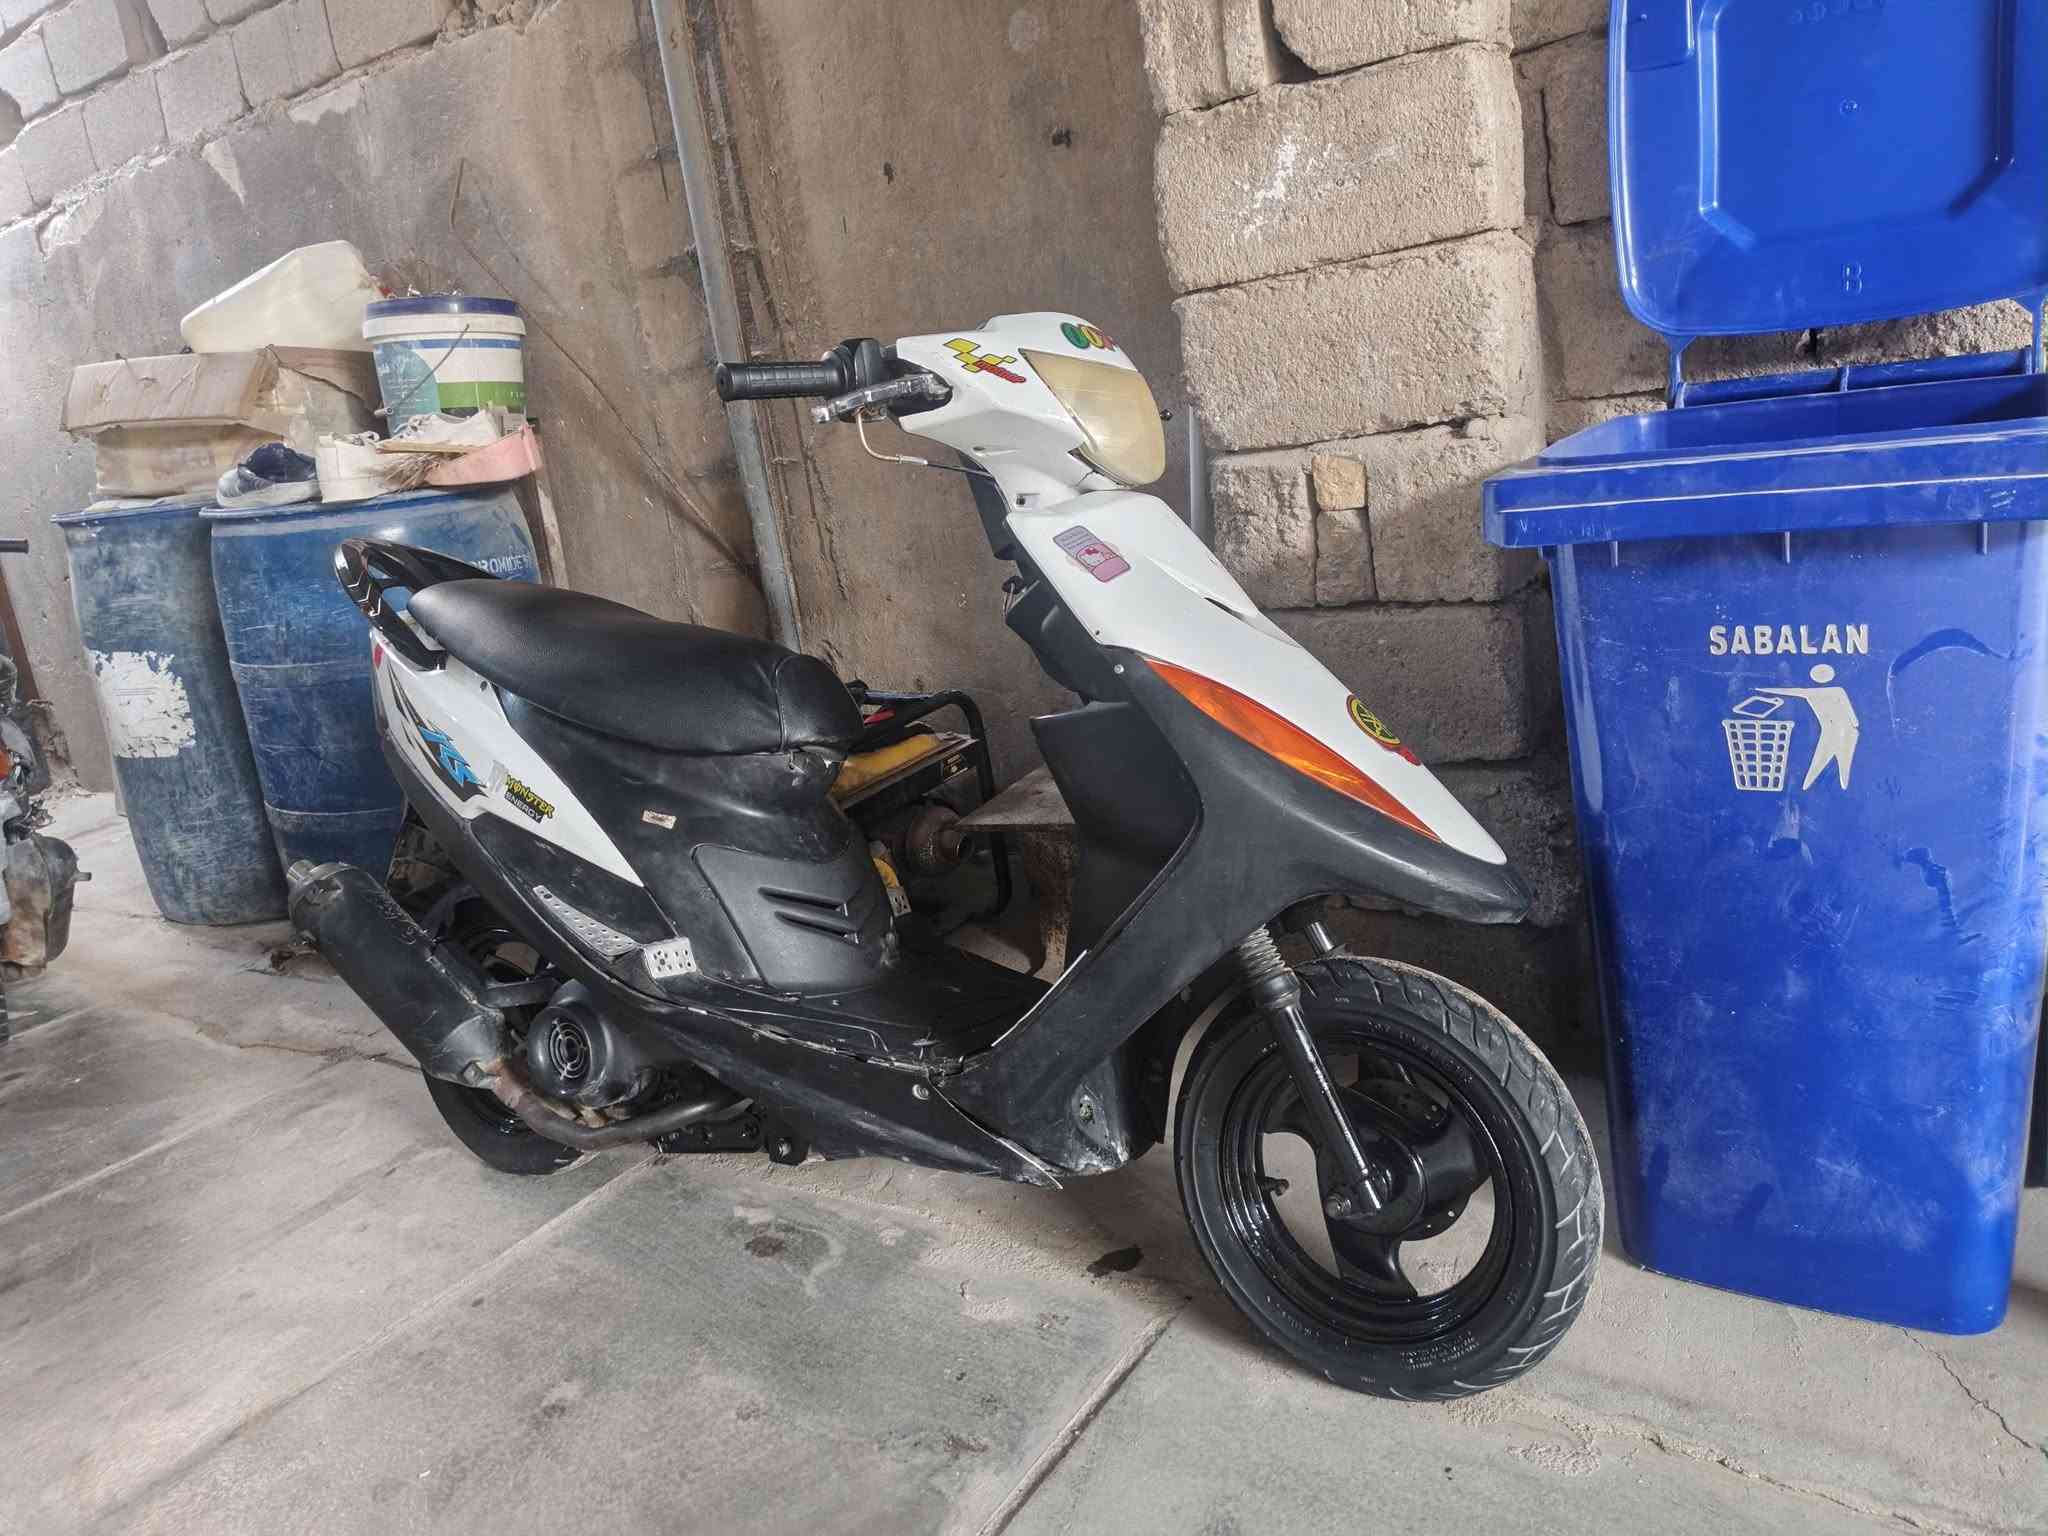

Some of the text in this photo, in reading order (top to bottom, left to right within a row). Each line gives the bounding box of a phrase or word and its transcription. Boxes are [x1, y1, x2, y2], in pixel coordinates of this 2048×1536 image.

[1710, 624, 1869, 655] SABALAN
[504, 790, 542, 822] ENERGY
[506, 774, 555, 819] MONSTER
